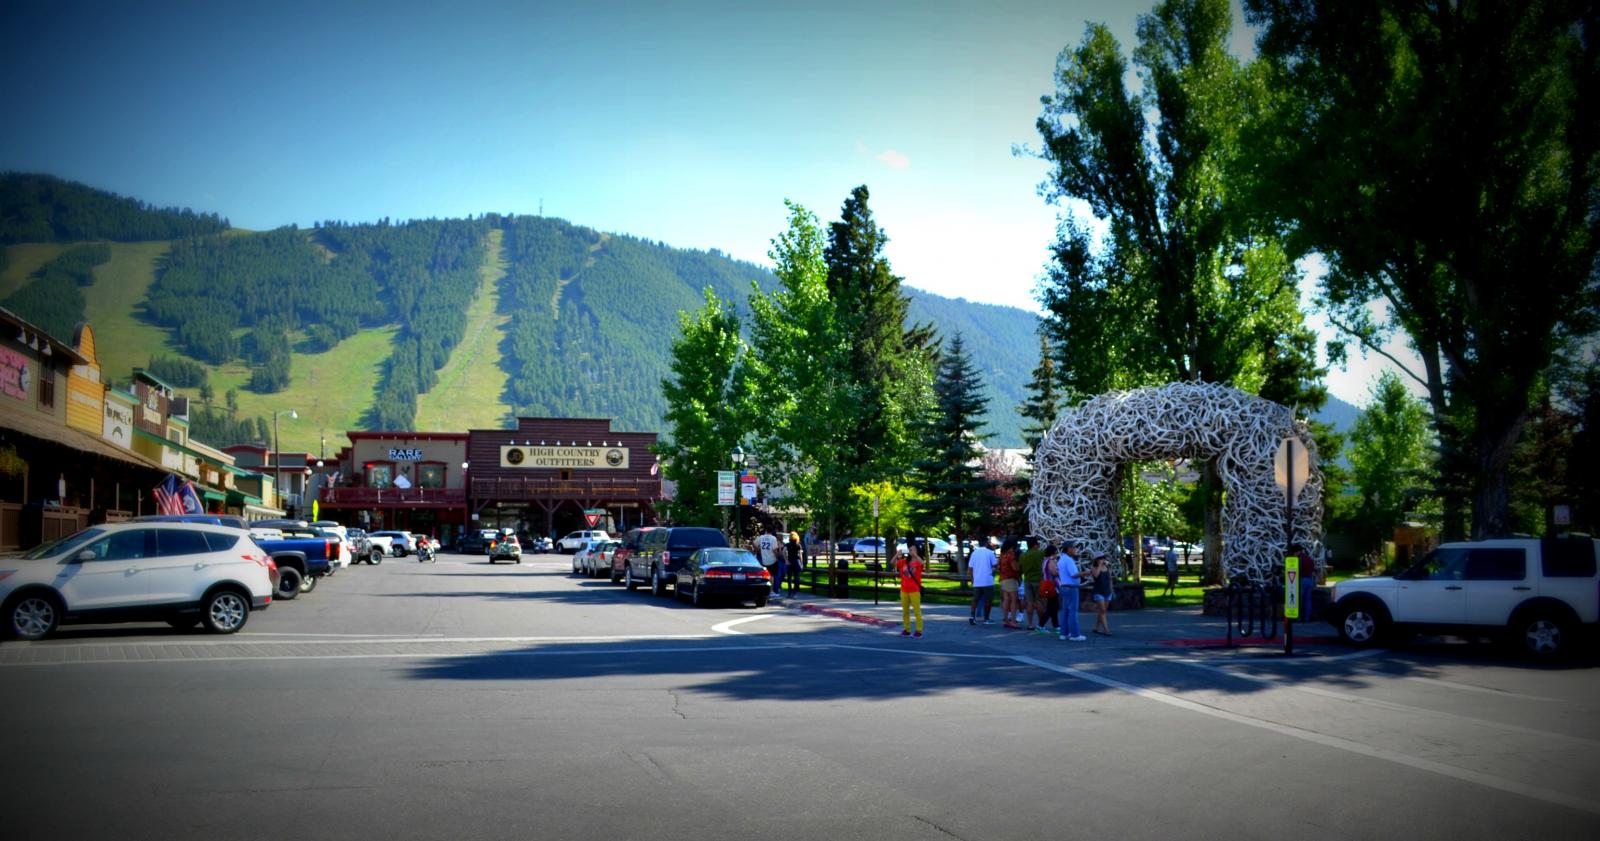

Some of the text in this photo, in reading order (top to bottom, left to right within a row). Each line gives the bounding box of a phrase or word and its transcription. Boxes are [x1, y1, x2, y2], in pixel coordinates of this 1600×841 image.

[529, 448, 554, 457] HIGH
[557, 448, 600, 458] COUNTRY
[536, 458, 595, 466] OUTFITTERS
[761, 541, 771, 550] 22
